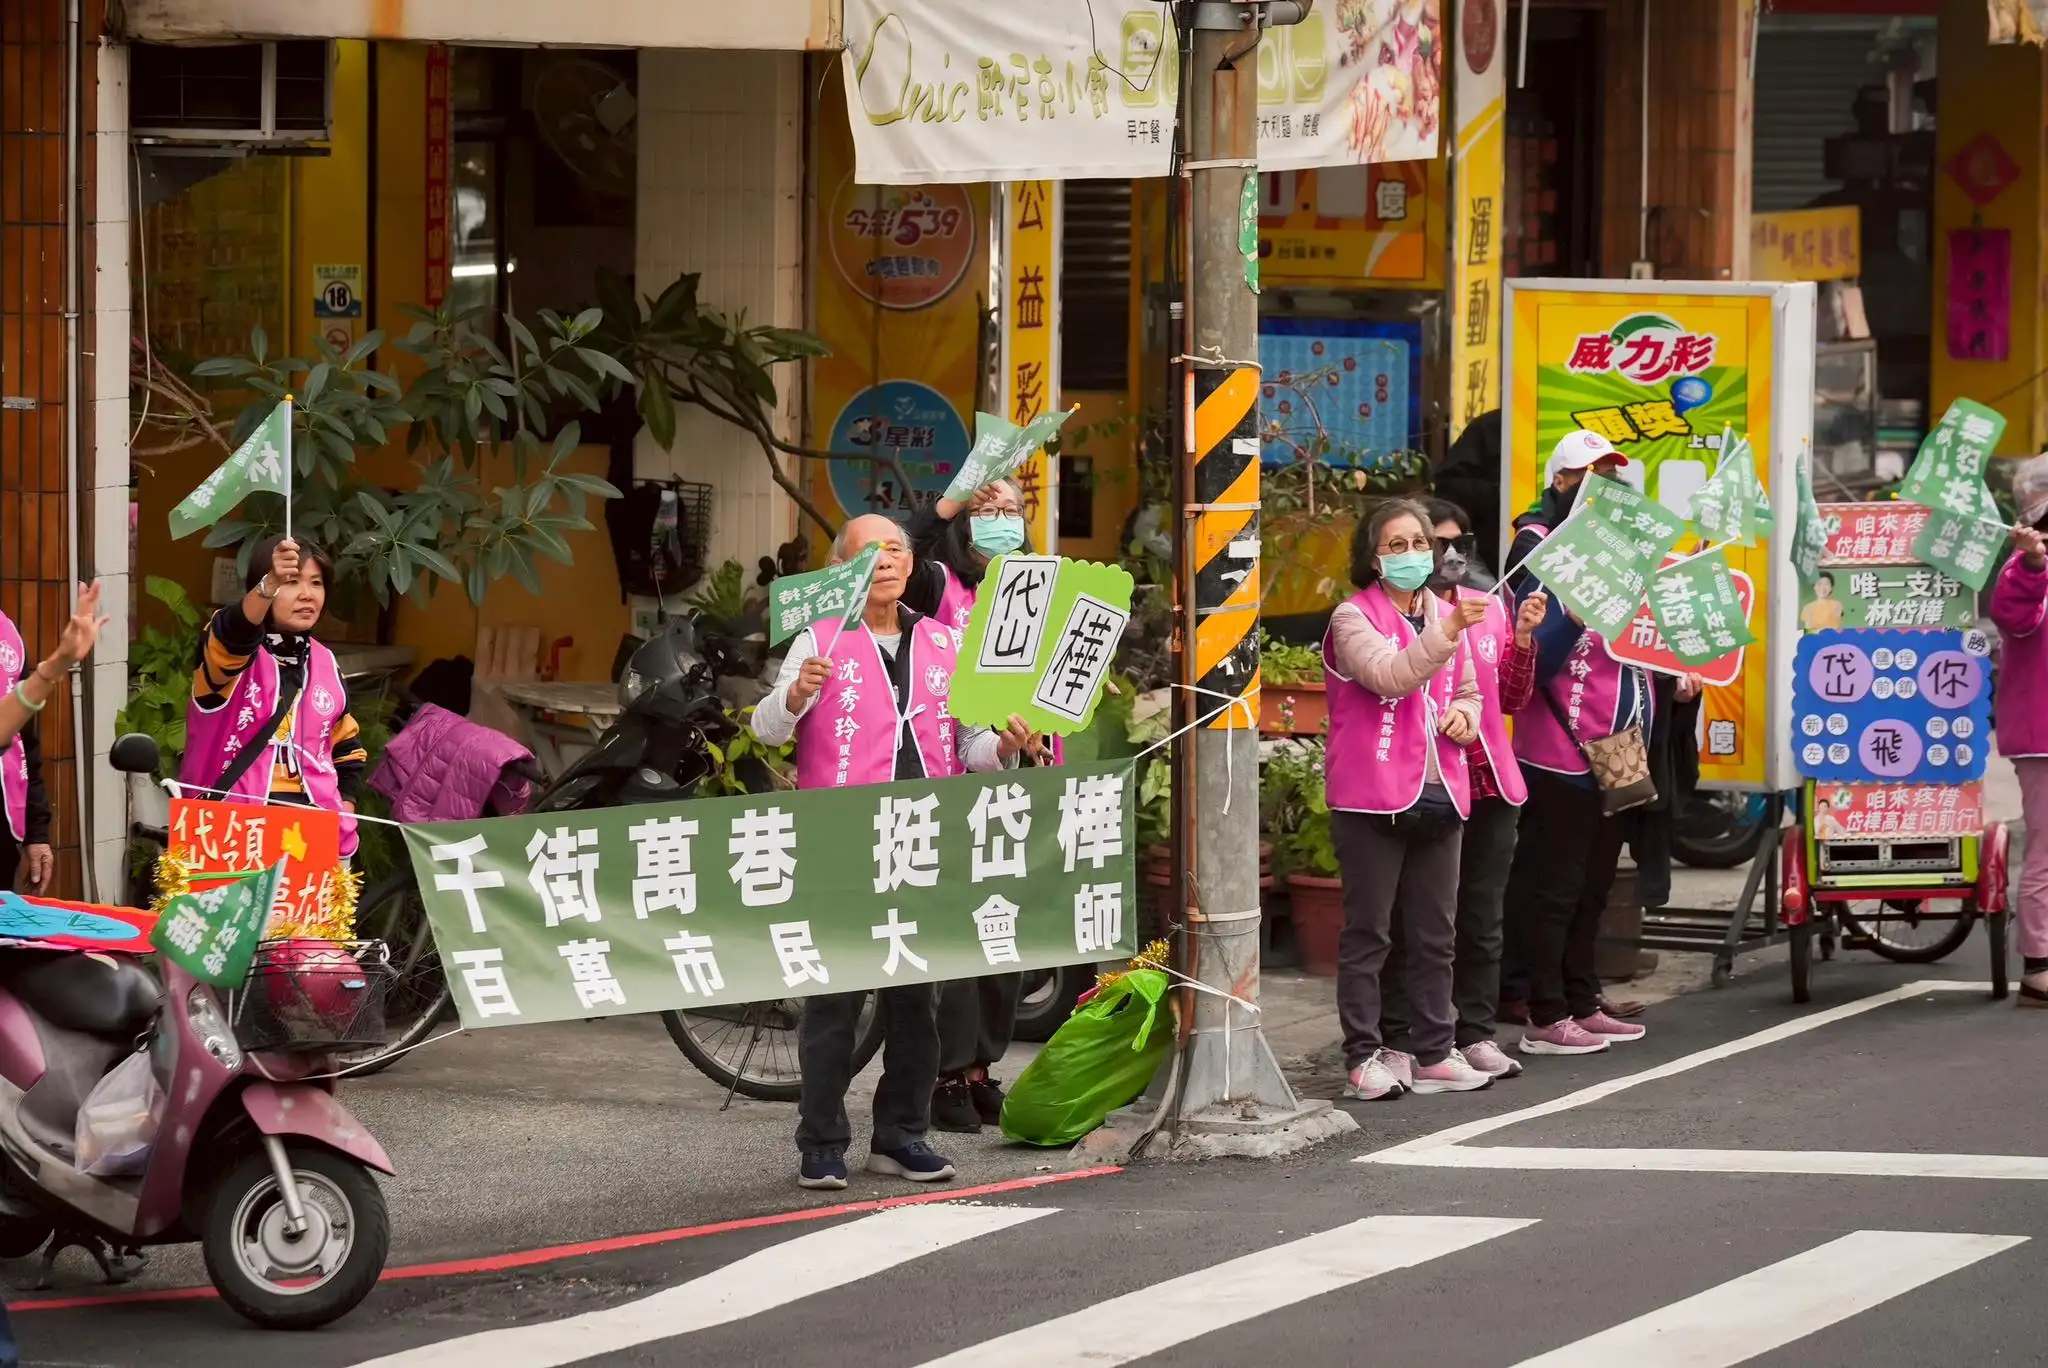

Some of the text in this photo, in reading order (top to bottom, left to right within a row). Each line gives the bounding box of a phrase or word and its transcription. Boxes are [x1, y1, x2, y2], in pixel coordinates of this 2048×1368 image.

[328, 286, 348, 308] 18
[1569, 333, 1715, 372] 威力彩
[1538, 542, 1633, 627] 林岱樺
[1850, 570, 1962, 600] 唯一支持
[1653, 572, 1712, 657] 林岱樺
[1864, 599, 1946, 626] 林岱樺
[1927, 658, 1969, 698] 你
[1870, 728, 1904, 767] 飛
[1866, 786, 1962, 809] 咱來疼惜
[1846, 808, 1978, 833] 岱樺高雄向前行
[429, 773, 1123, 933] 千街萬巷 挺岱樺
[451, 881, 1122, 1019] 百萬市民大會師
